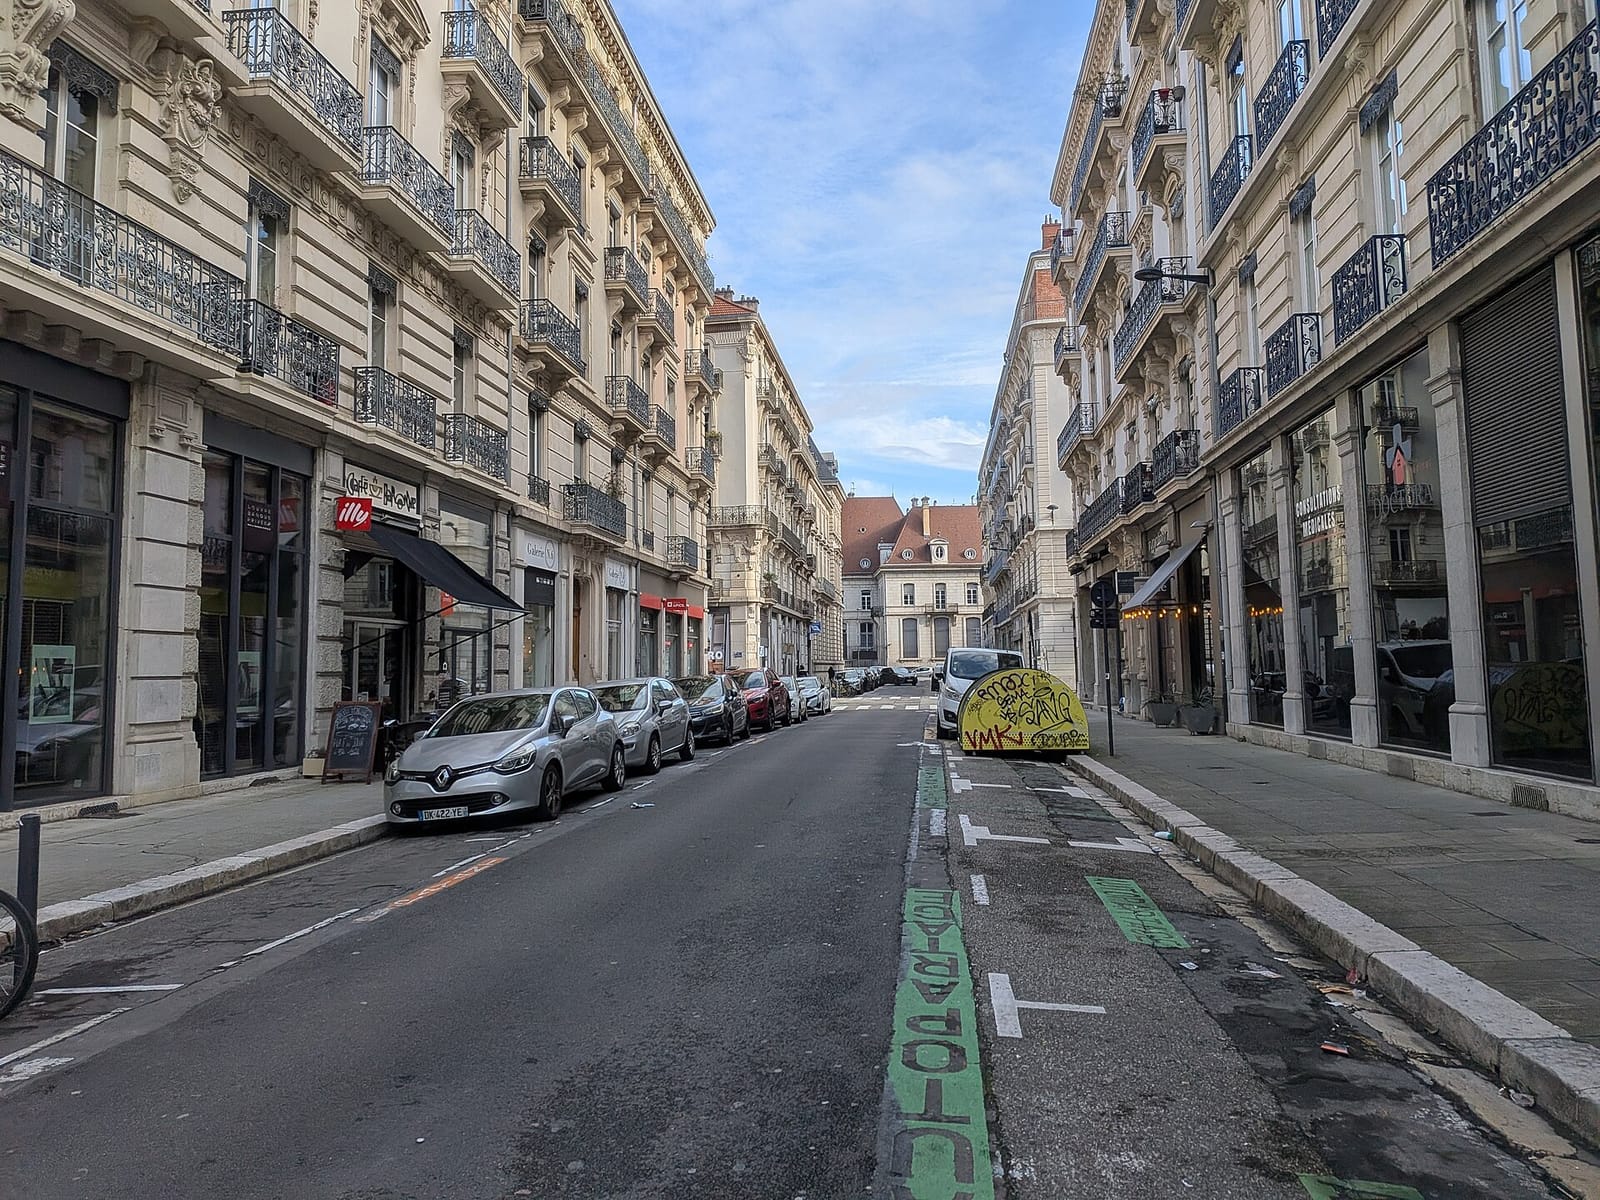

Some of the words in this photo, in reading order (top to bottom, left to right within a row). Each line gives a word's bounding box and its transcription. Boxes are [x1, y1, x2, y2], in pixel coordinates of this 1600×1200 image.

[338, 502, 369, 527] illy
[1295, 485, 1341, 518] CONSULTATIONS
[1302, 512, 1335, 537] MÉDICALES
[889, 890, 974, 1200] UTOPARTAGE
